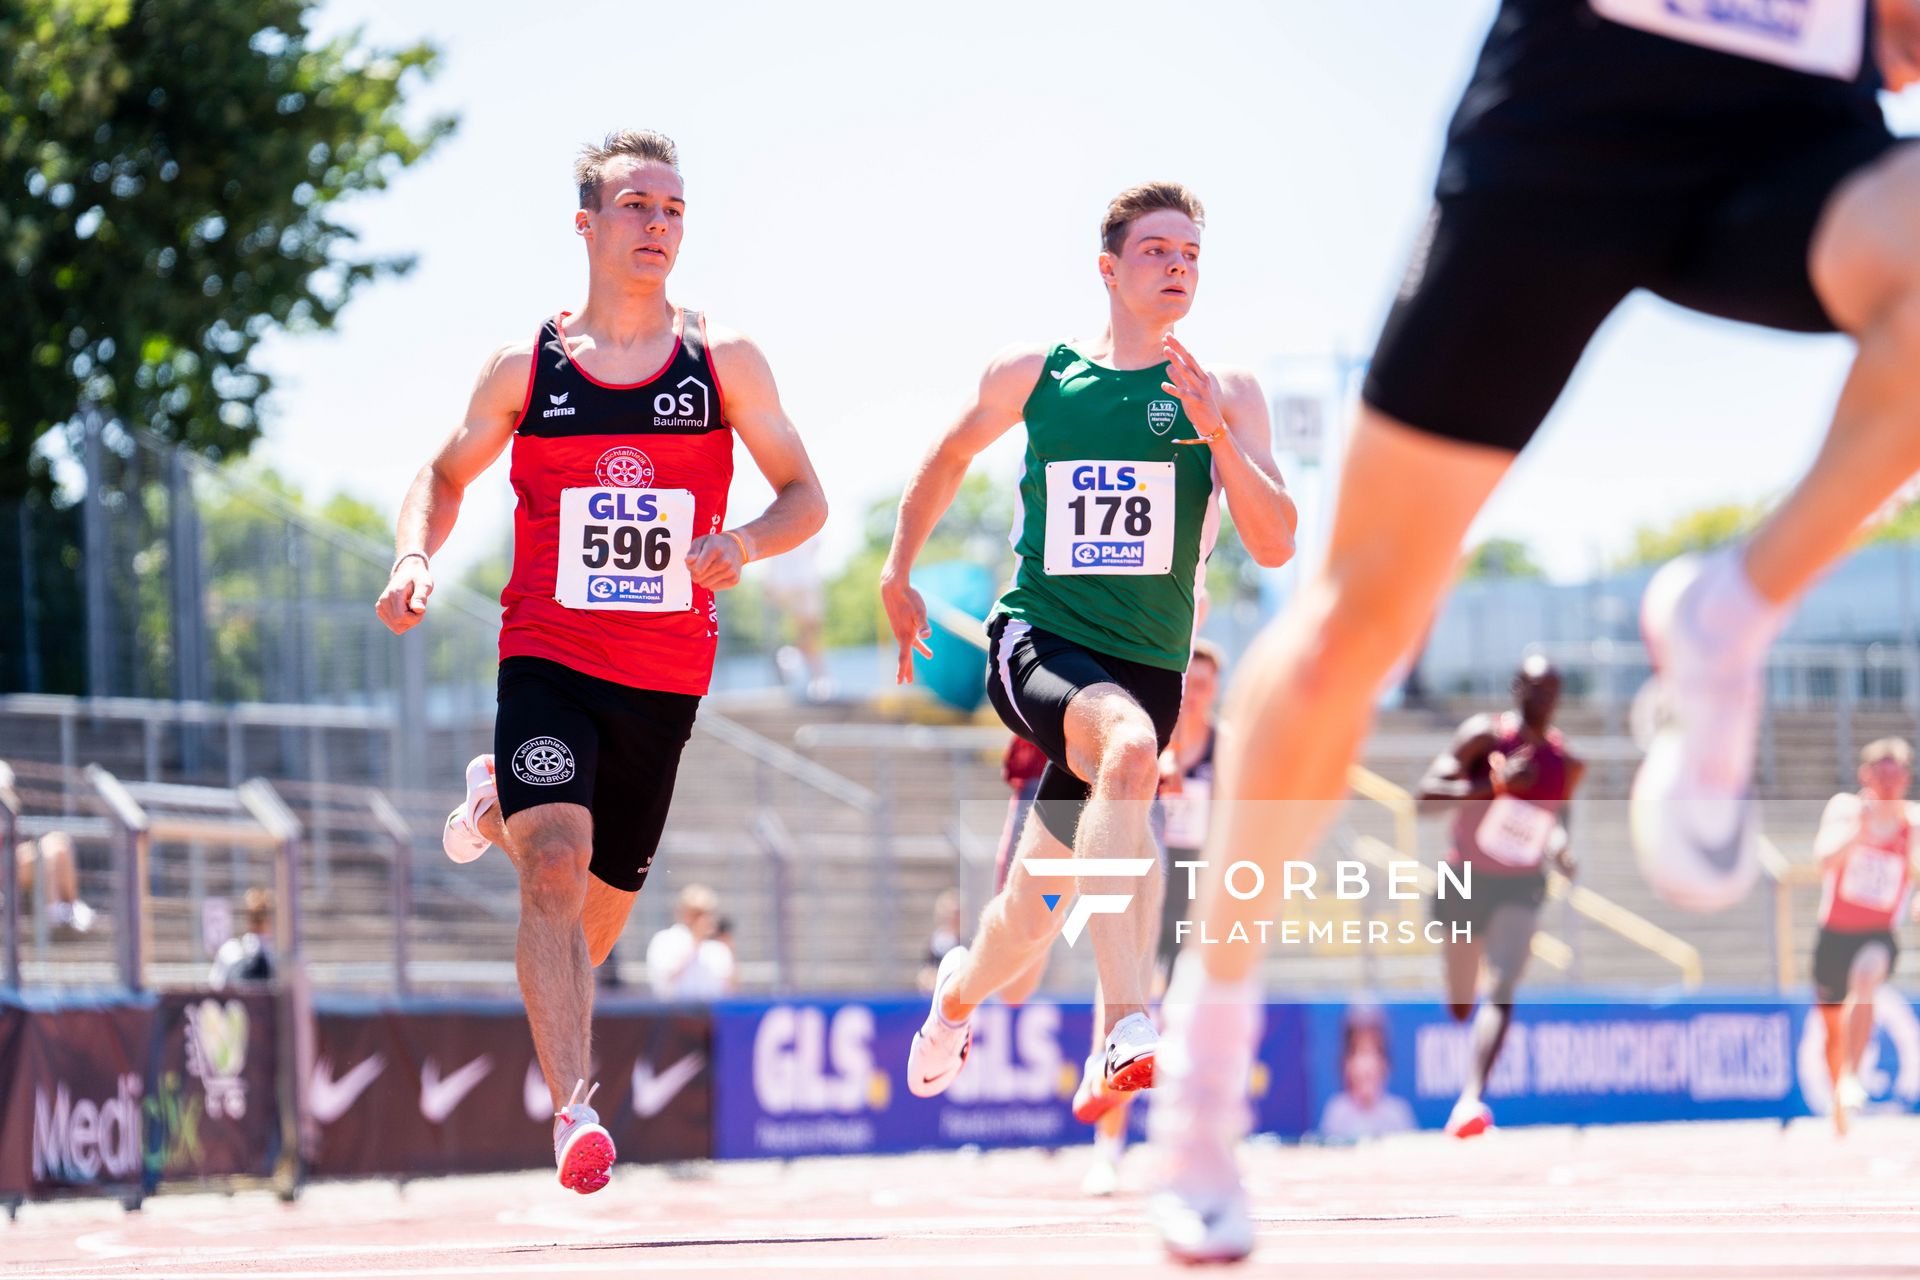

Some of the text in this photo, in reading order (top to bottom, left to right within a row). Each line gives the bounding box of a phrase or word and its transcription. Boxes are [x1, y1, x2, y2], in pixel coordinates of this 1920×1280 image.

[543, 407, 576, 418] erima
[653, 393, 695, 416] OS
[653, 416, 703, 427] BauImmo
[600, 449, 646, 466] Leichtathletik
[1072, 465, 1147, 491] GLS.
[588, 492, 668, 522] GLS.
[1068, 495, 1152, 537] 178
[582, 525, 671, 571] 596
[1101, 546, 1142, 558] PLAN
[619, 580, 661, 594] PLAN
[517, 739, 567, 758] Leichtathletik
